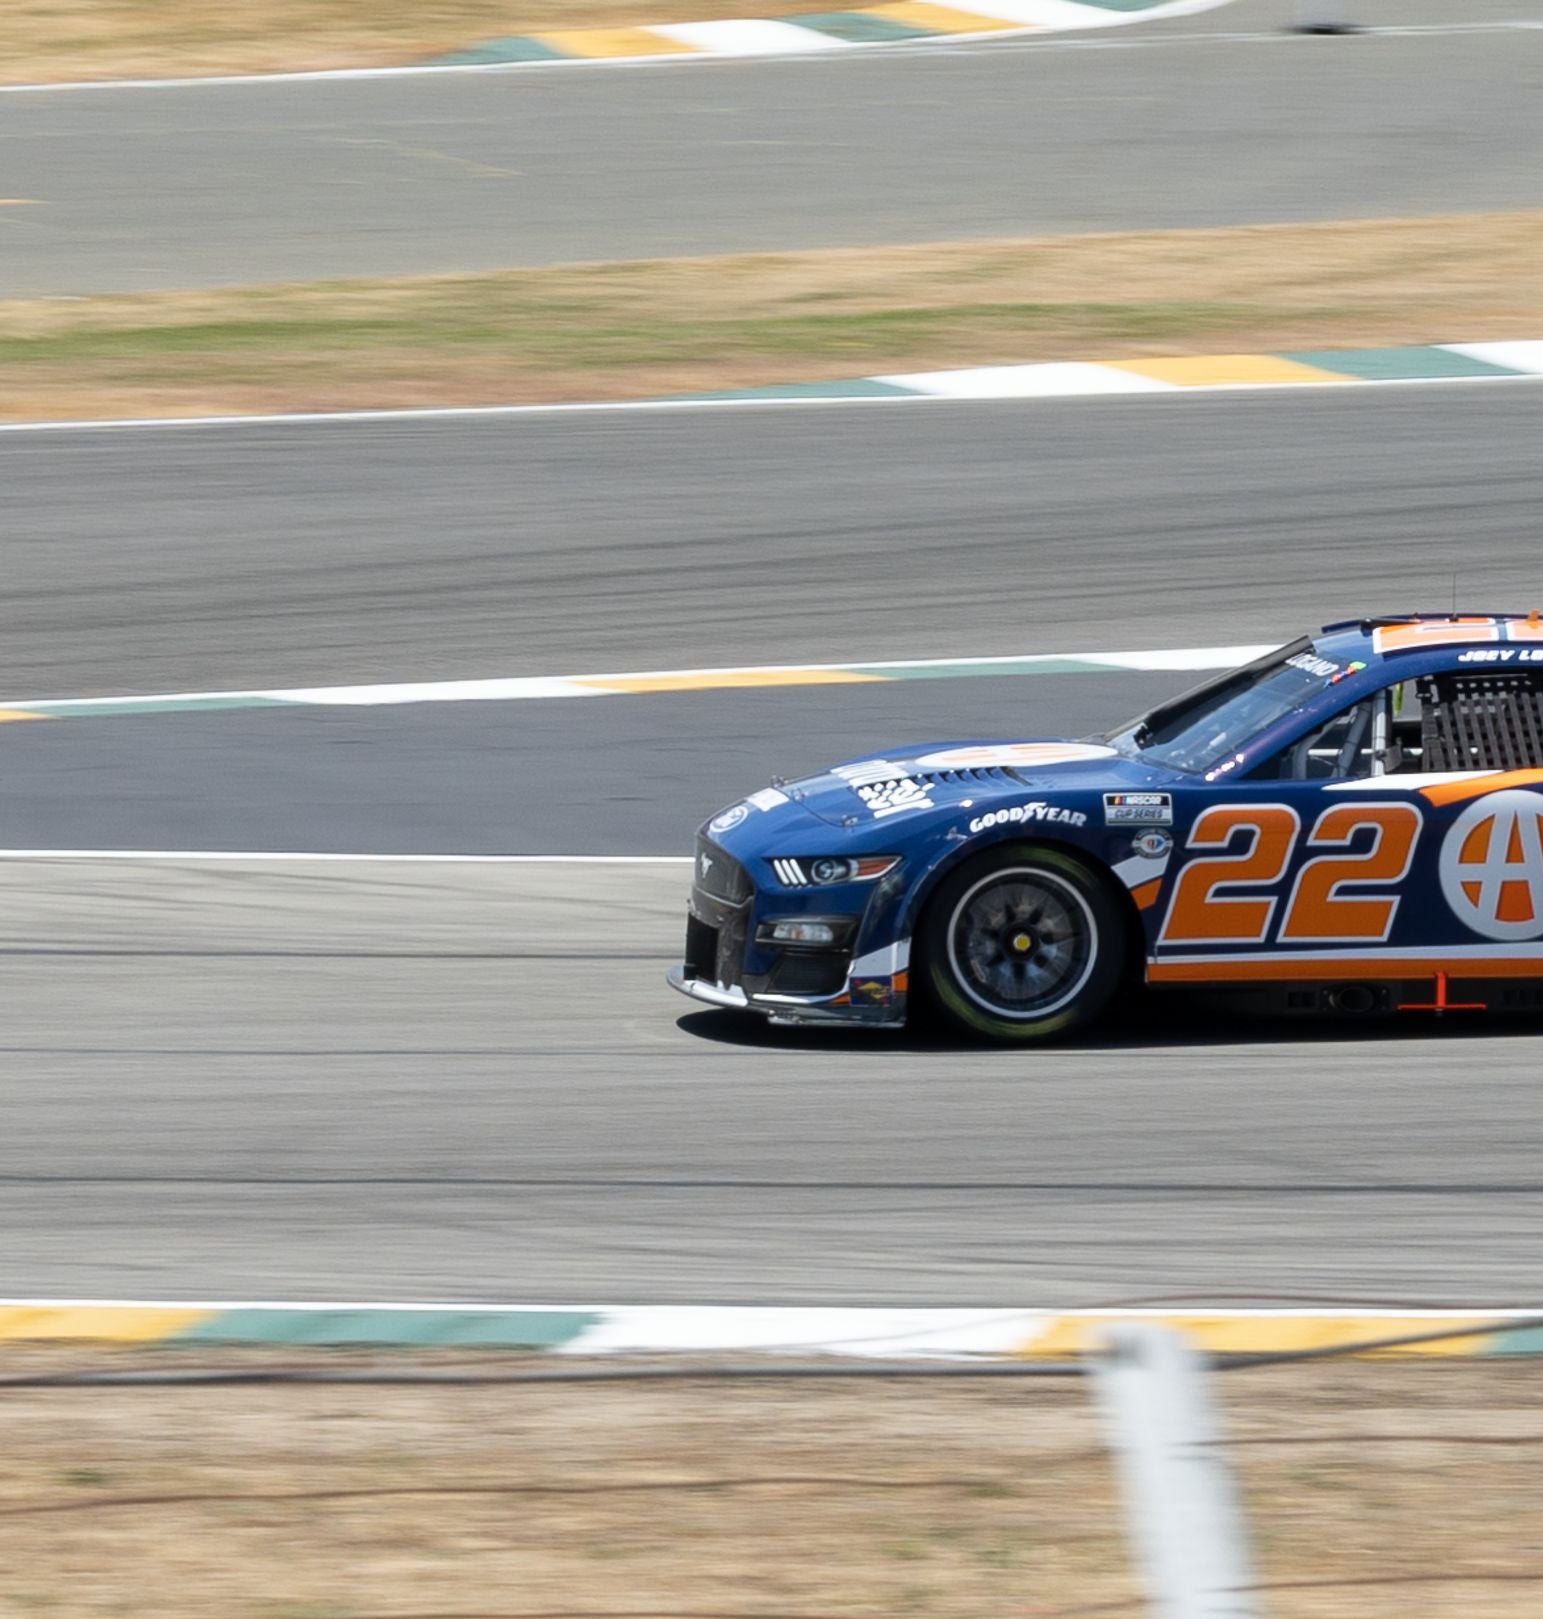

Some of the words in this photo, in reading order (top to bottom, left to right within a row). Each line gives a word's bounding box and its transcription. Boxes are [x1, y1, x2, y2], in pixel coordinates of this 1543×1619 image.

[1284, 652, 1340, 677] LOGANO
[1458, 650, 1515, 661] JOEY
[969, 802, 1087, 833] GOODYEAR
[1157, 801, 1424, 945] 22
